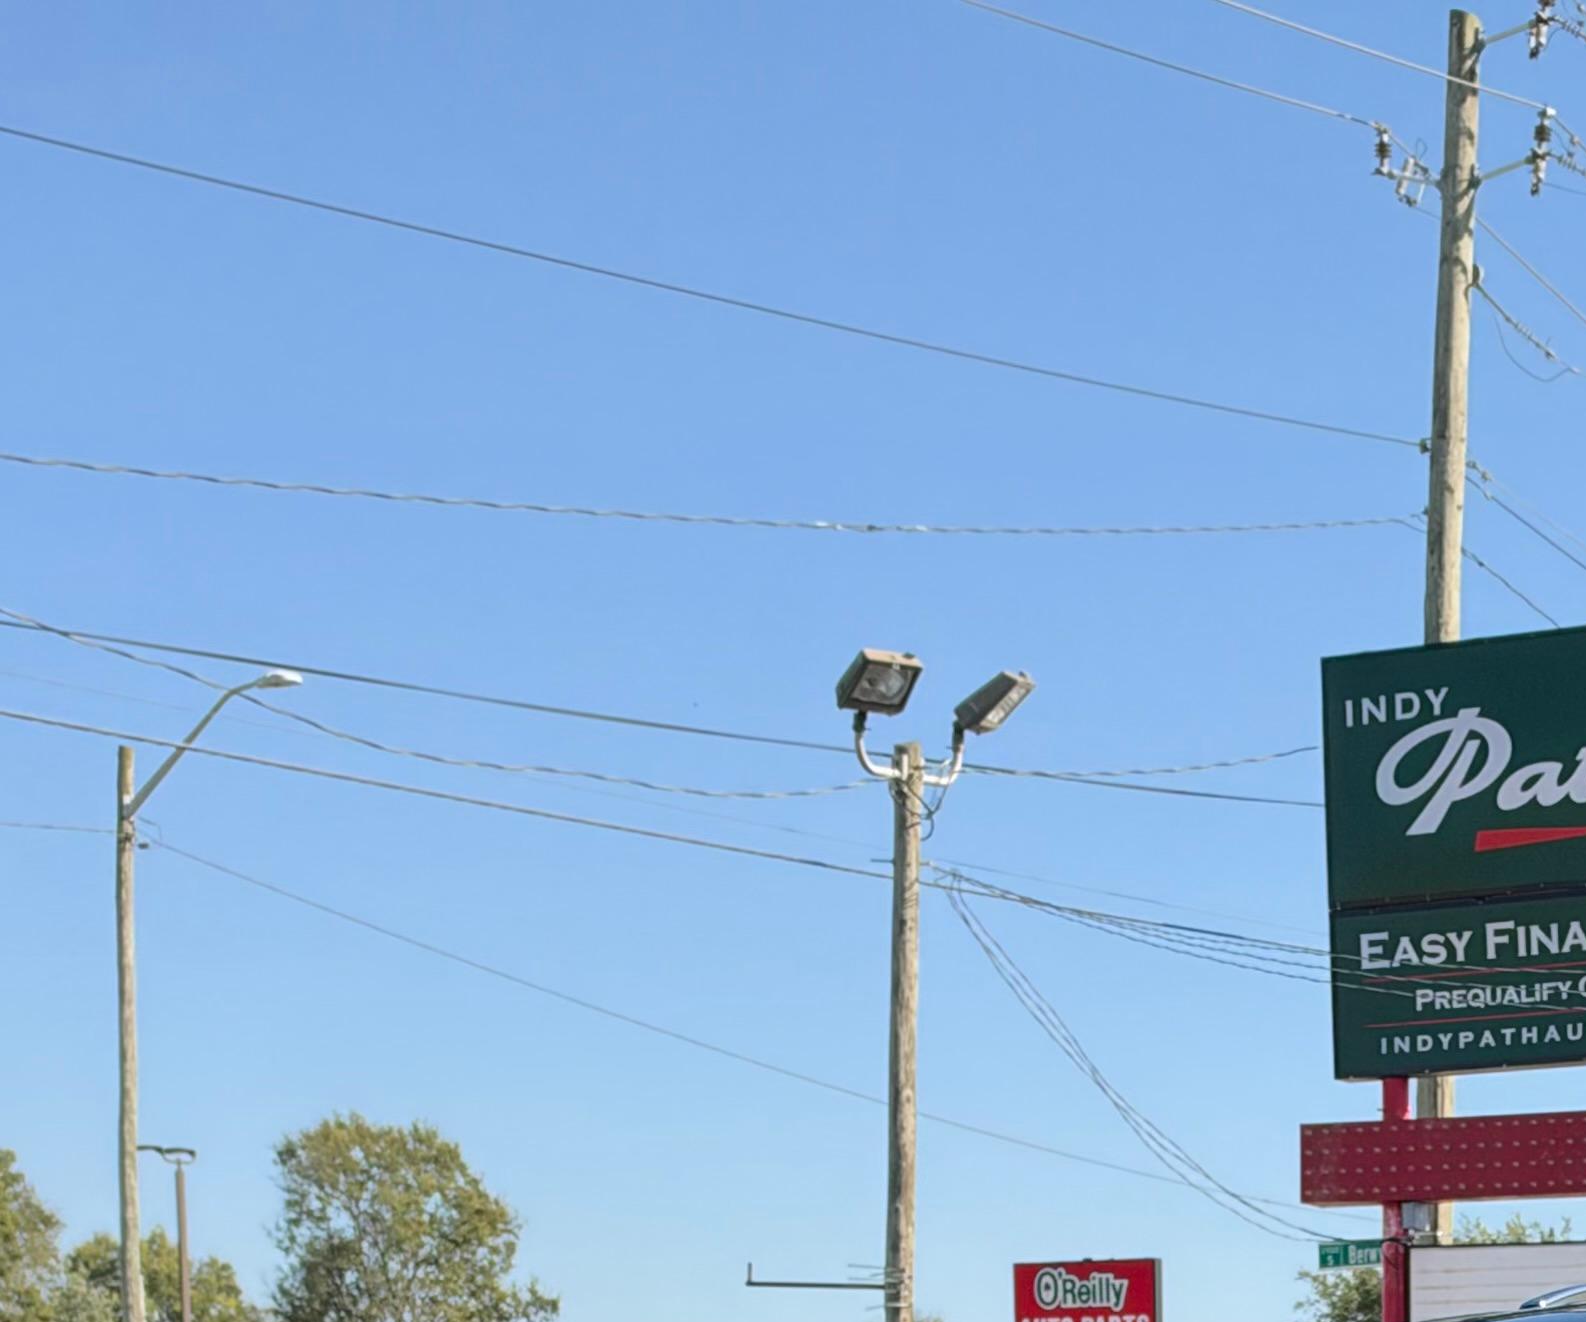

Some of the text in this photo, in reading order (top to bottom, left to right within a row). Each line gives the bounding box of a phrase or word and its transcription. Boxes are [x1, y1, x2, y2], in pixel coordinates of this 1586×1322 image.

[1344, 686, 1449, 727] INDY
[1359, 931, 1473, 970] EASY
[1415, 979, 1574, 1012] PREQUALIFY
[1036, 1270, 1125, 1309] O'Reilly
